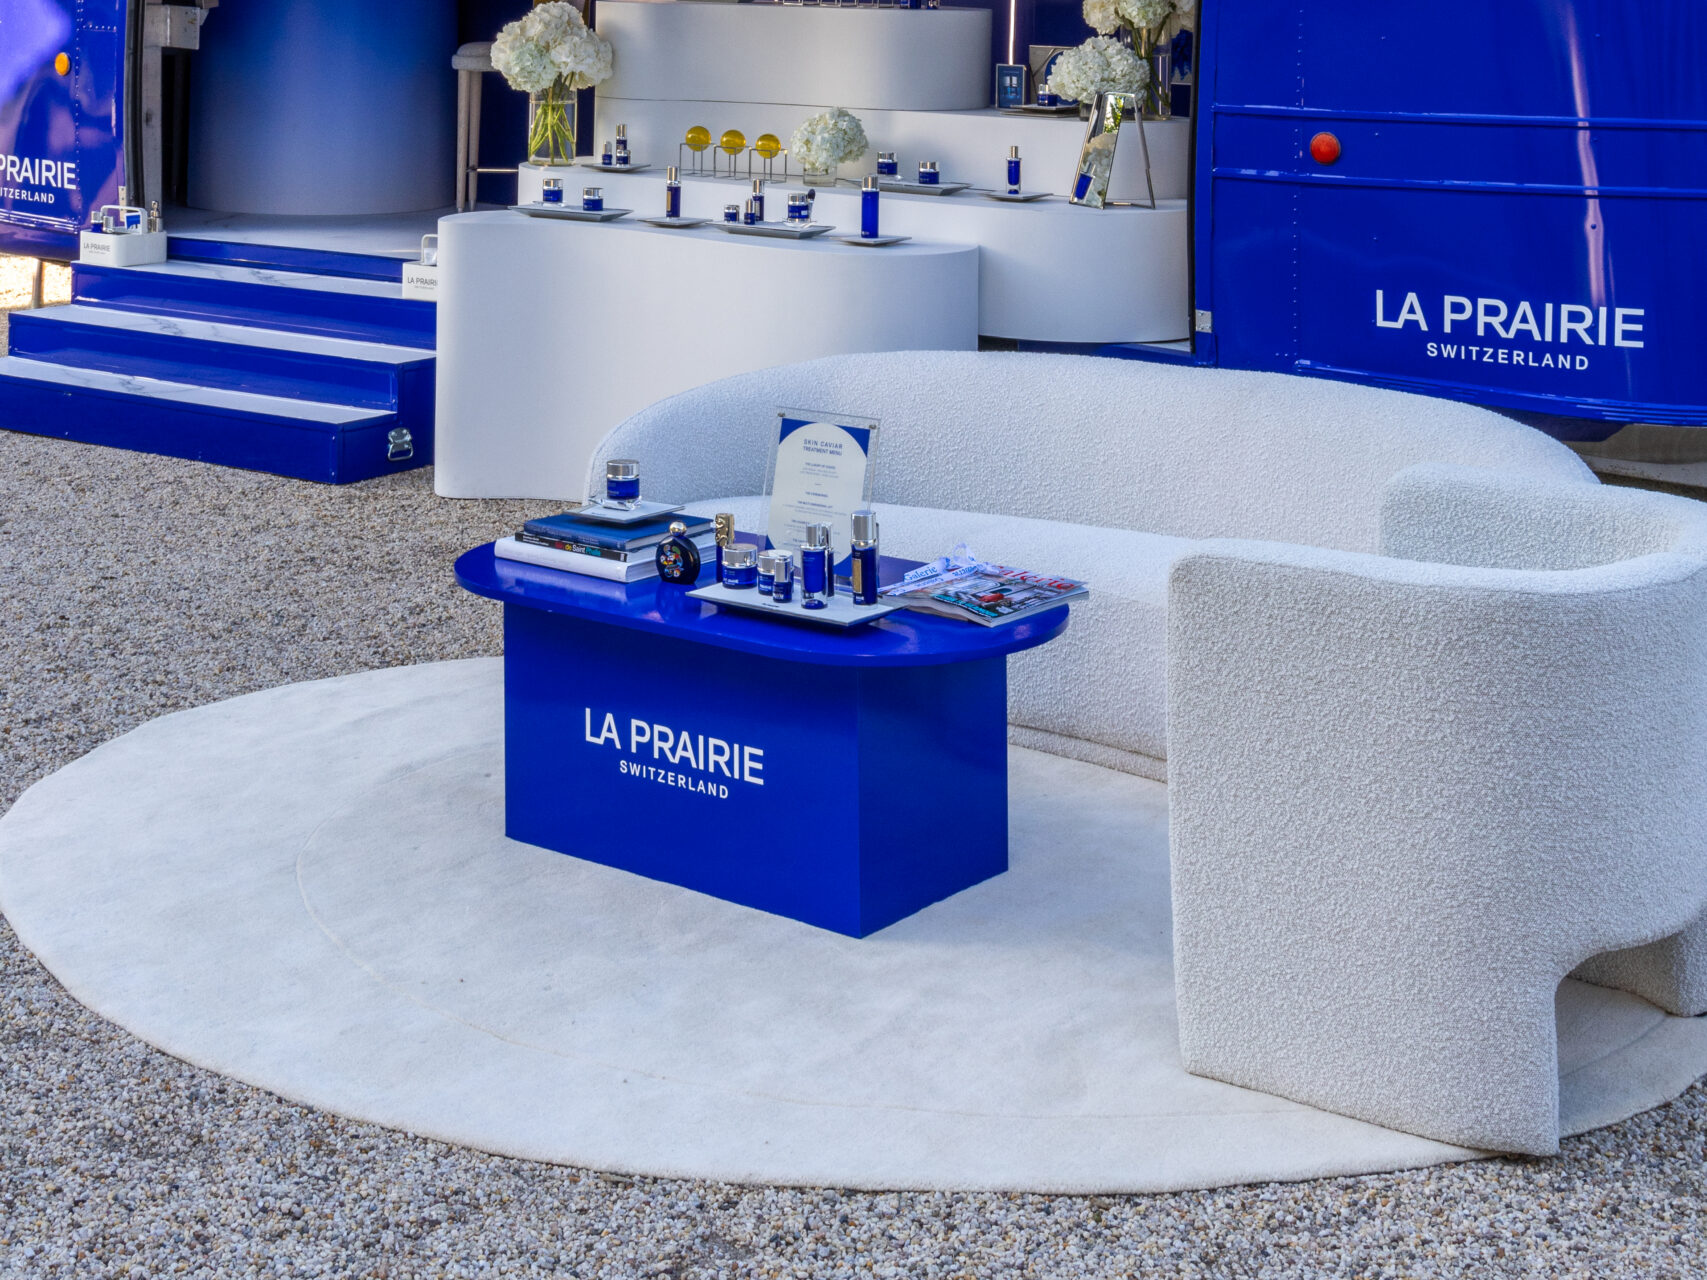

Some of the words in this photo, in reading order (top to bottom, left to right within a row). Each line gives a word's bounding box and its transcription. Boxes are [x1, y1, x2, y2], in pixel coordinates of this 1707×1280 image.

[0, 186, 55, 204] ITZERLAND
[407, 276, 415, 284] LA
[415, 277, 437, 287] PRAIRI
[1376, 289, 1429, 332] LA
[1443, 294, 1645, 348] PRAIRIE
[1426, 341, 1589, 371] SWITZERLAND
[803, 438, 818, 446] SKIN
[820, 441, 843, 449] CAVIAR
[572, 544, 586, 554] Saint
[999, 566, 1075, 589] alerie
[585, 707, 622, 750] LA
[631, 718, 765, 786] PRAIRIE
[619, 759, 729, 799] SWITZERLAND
